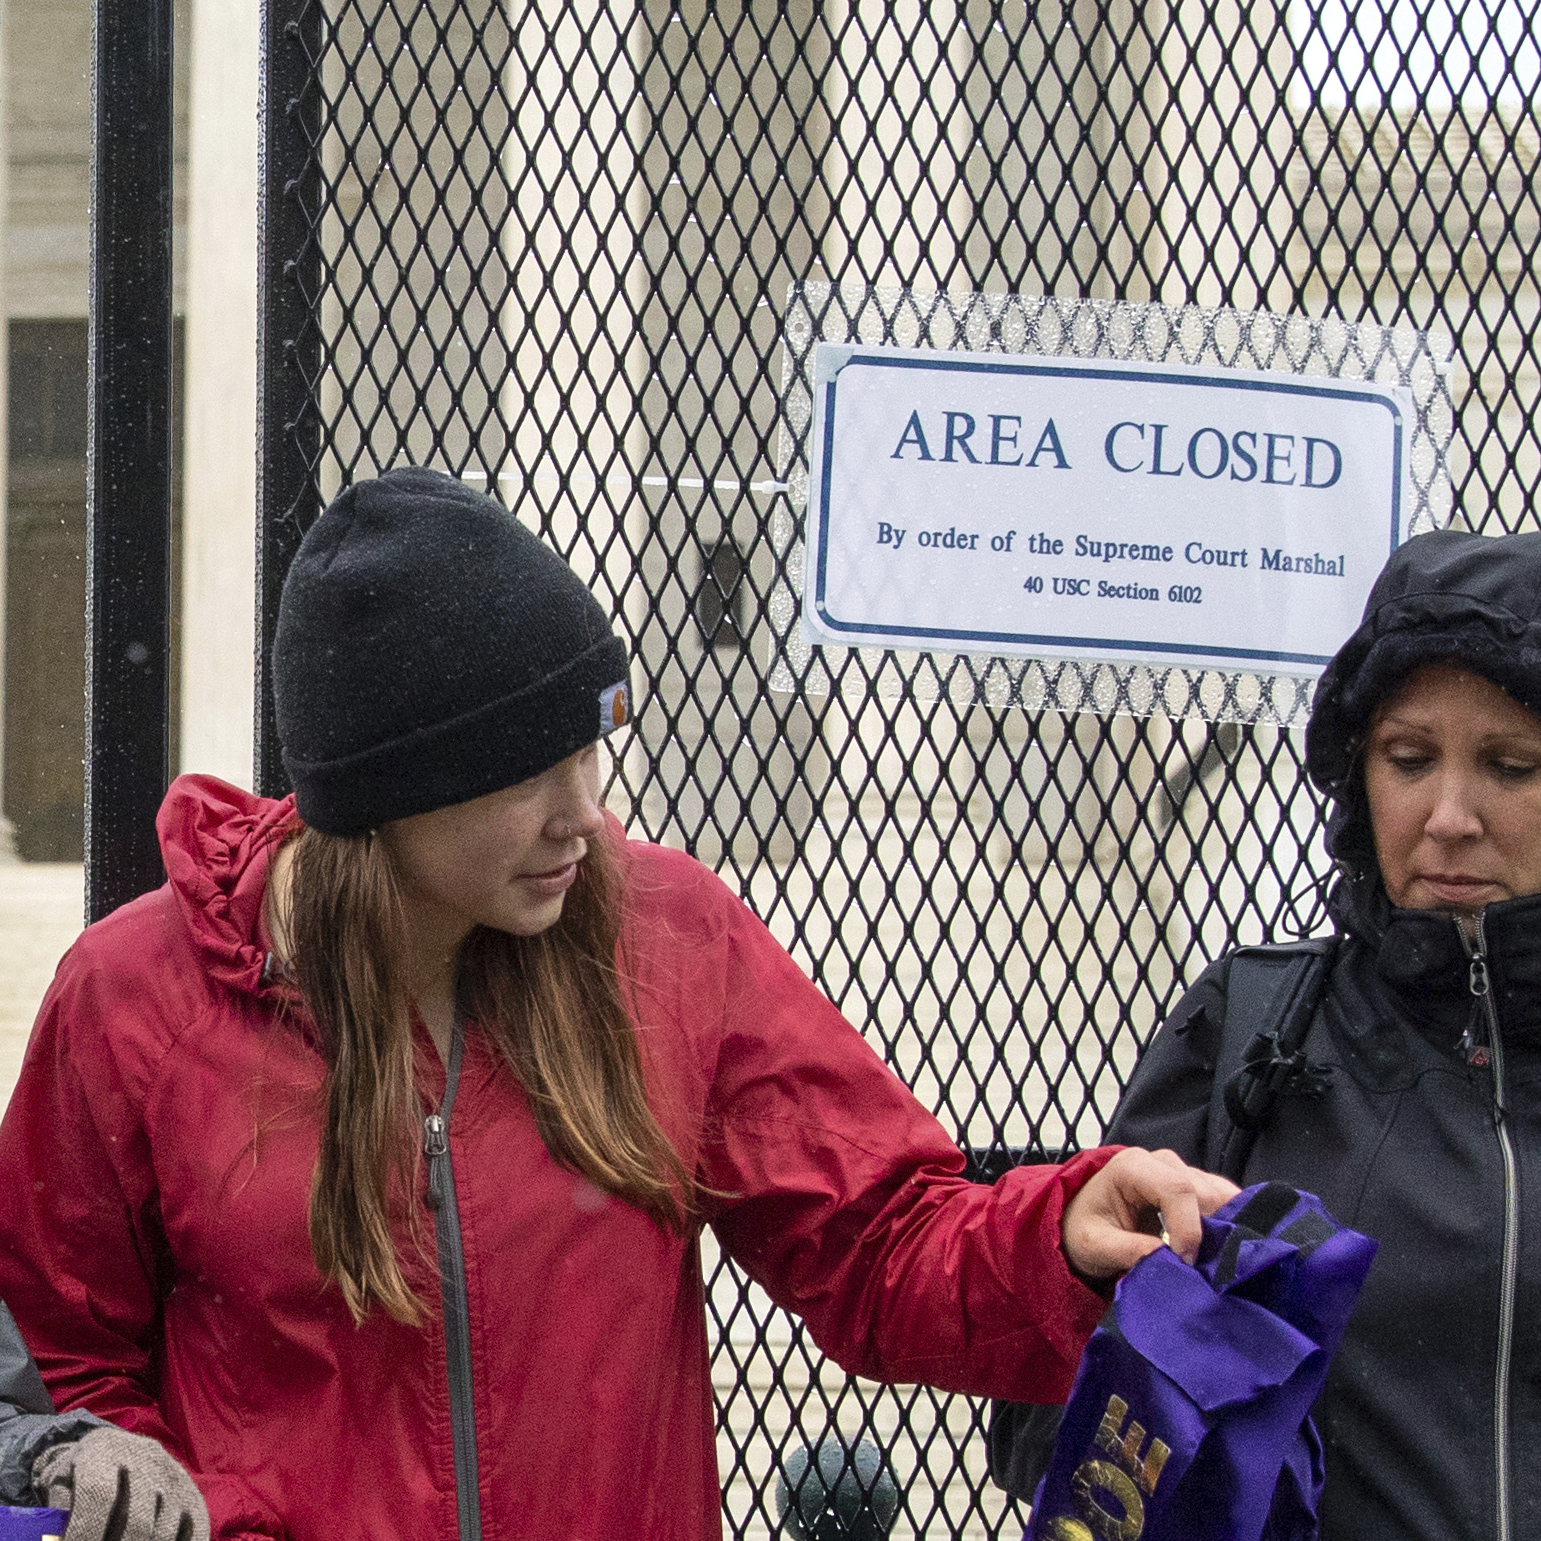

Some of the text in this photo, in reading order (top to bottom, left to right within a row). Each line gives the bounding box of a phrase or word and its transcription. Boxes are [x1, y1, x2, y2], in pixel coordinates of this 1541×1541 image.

[889, 408, 1343, 489] AREA CLOSED
[876, 521, 1346, 577] By order of the Supreme Court Marshal
[1023, 575, 1203, 604] 40 USC Section 6102
